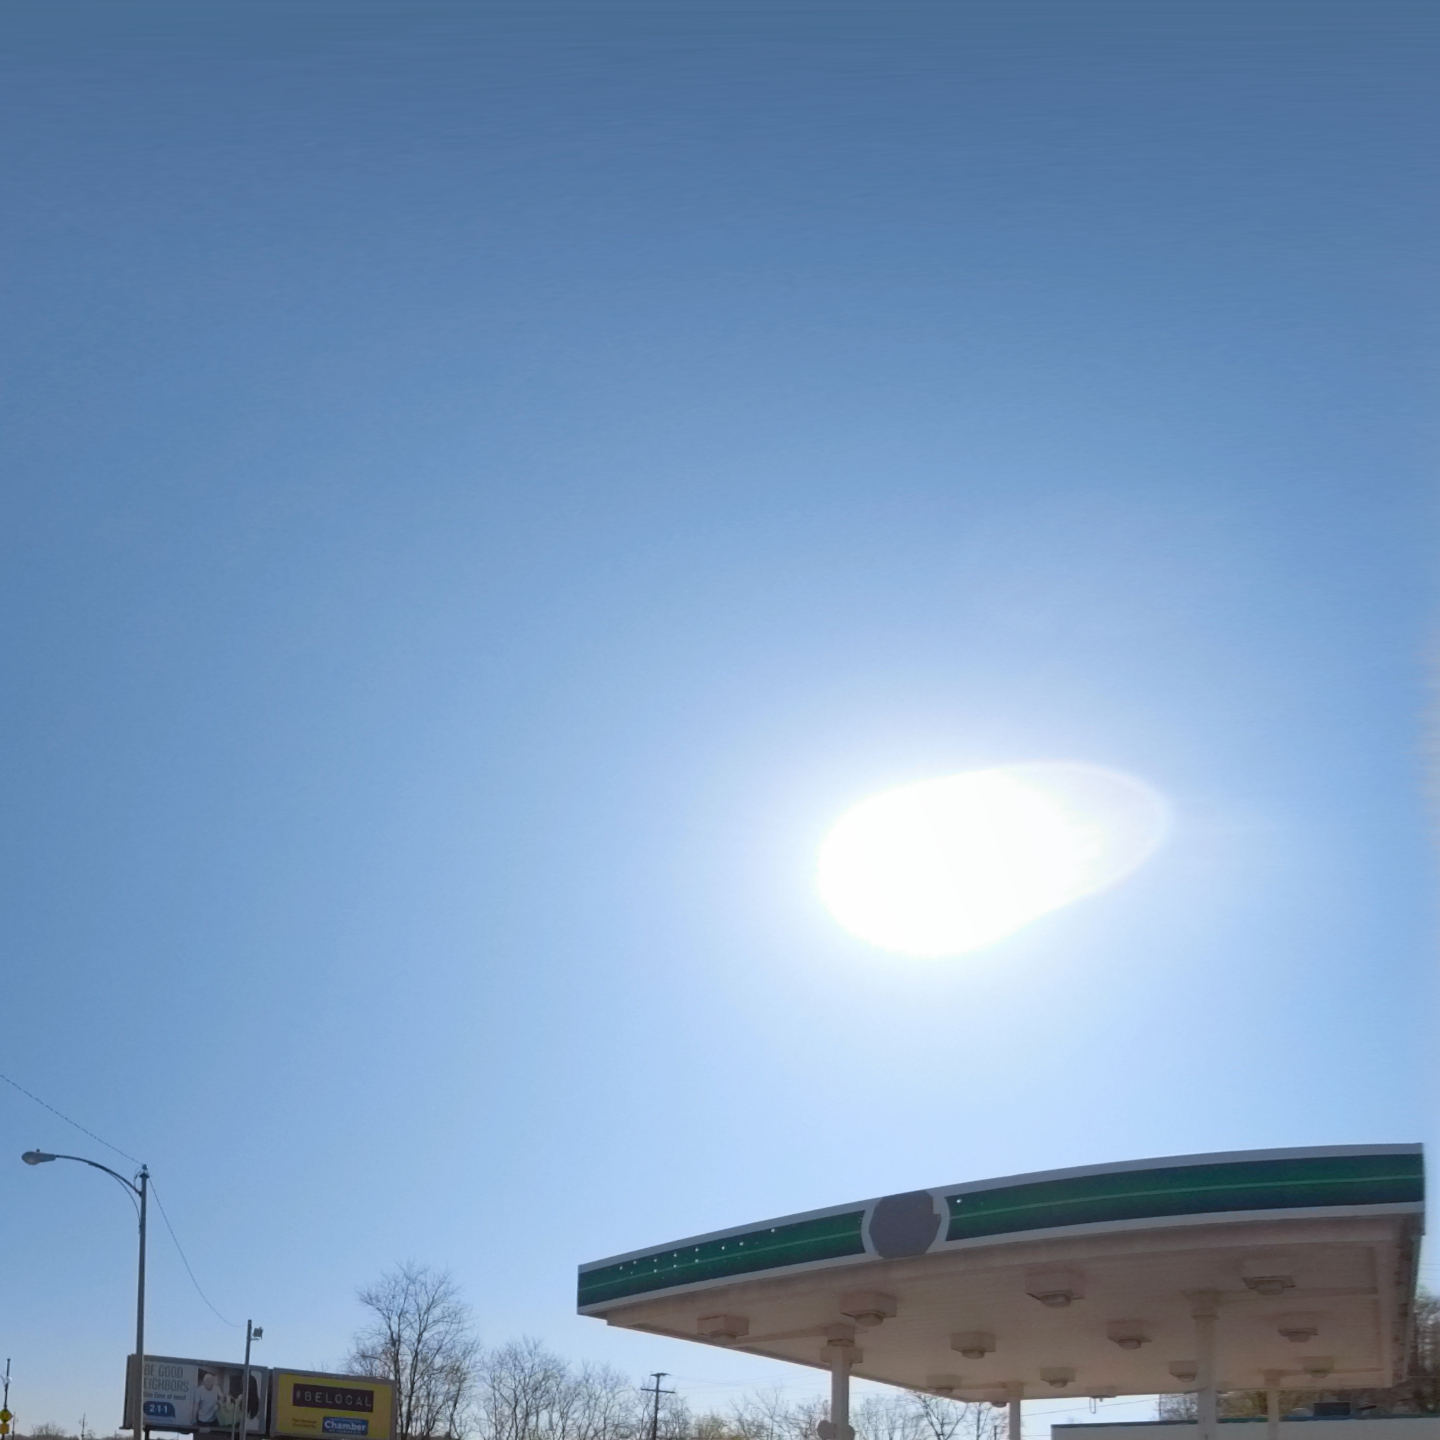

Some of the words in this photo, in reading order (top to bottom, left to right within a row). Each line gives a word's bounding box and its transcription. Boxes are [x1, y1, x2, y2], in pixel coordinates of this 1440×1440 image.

[144, 1364, 155, 1376] BE
[158, 1365, 183, 1378] GOOD
[143, 1378, 189, 1392] EIGHBORS
[296, 1390, 372, 1406] #BELOCAL
[324, 1420, 367, 1431] Chamber
